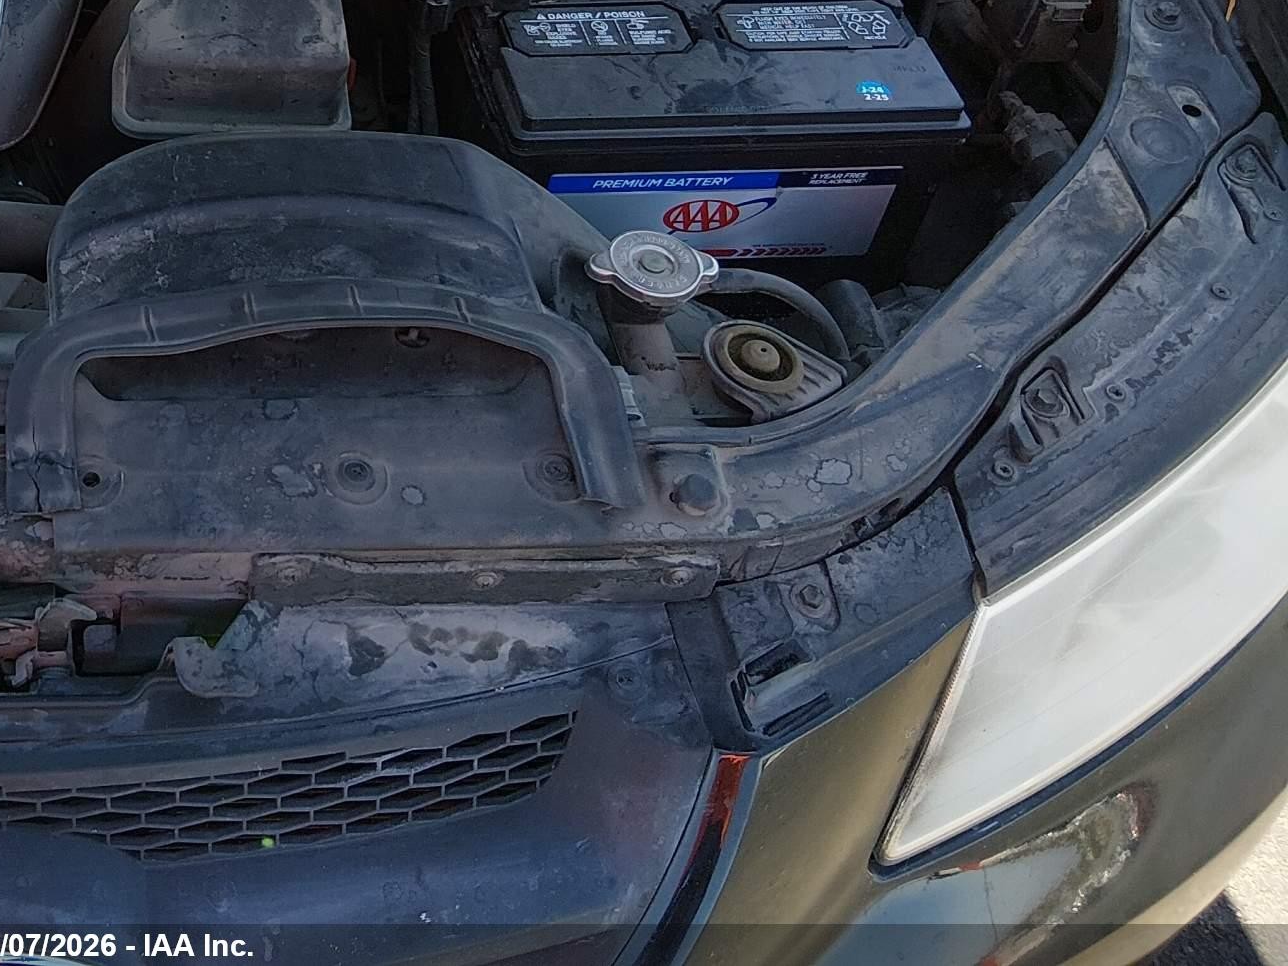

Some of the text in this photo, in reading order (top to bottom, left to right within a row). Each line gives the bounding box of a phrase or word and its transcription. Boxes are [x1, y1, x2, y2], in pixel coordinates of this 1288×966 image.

[603, 10, 645, 19] POISON
[593, 177, 734, 189] PREMIUM BATTERY
[667, 200, 735, 232] AAA
